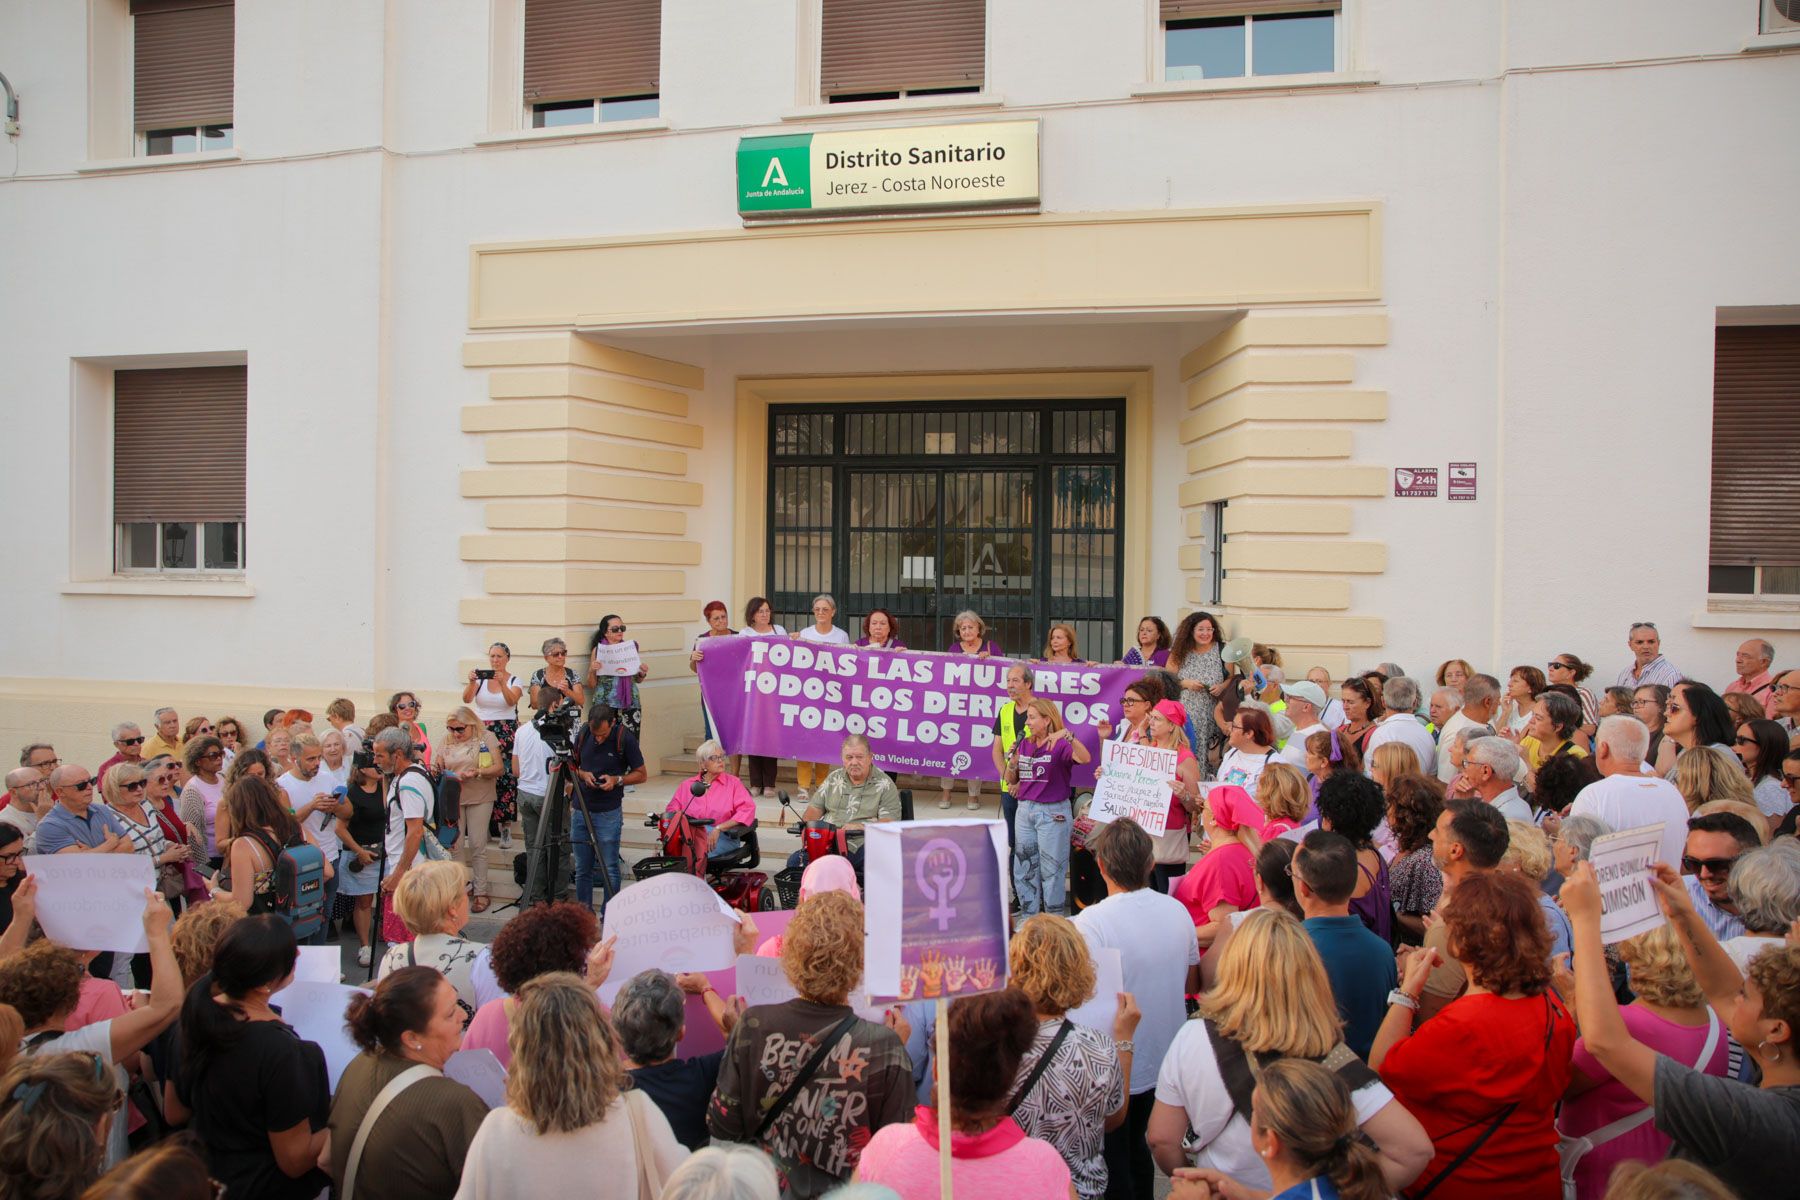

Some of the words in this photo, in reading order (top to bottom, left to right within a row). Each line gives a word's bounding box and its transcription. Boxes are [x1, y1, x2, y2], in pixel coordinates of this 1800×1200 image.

[826, 149, 902, 169] Distrito
[908, 143, 1006, 164] Sanitario
[764, 189, 772, 197] de
[773, 187, 805, 196] Andalucía
[826, 180, 868, 195] Jerez
[882, 177, 926, 193] Costa
[931, 173, 1006, 190] Noroeste
[1415, 476, 1436, 484] 24h
[751, 641, 858, 677] TODAS
[867, 656, 934, 684] LAS
[943, 662, 1101, 695] MUJRES
[744, 670, 843, 703] TODOS
[851, 685, 913, 712] LOS
[780, 703, 887, 739] TODOS
[896, 718, 960, 745] LOS
[888, 754, 919, 766] Violeta
[921, 758, 946, 769] Jerez
[1110, 744, 1177, 774] PRESIDENTE
[1100, 802, 1127, 816] SALUD
